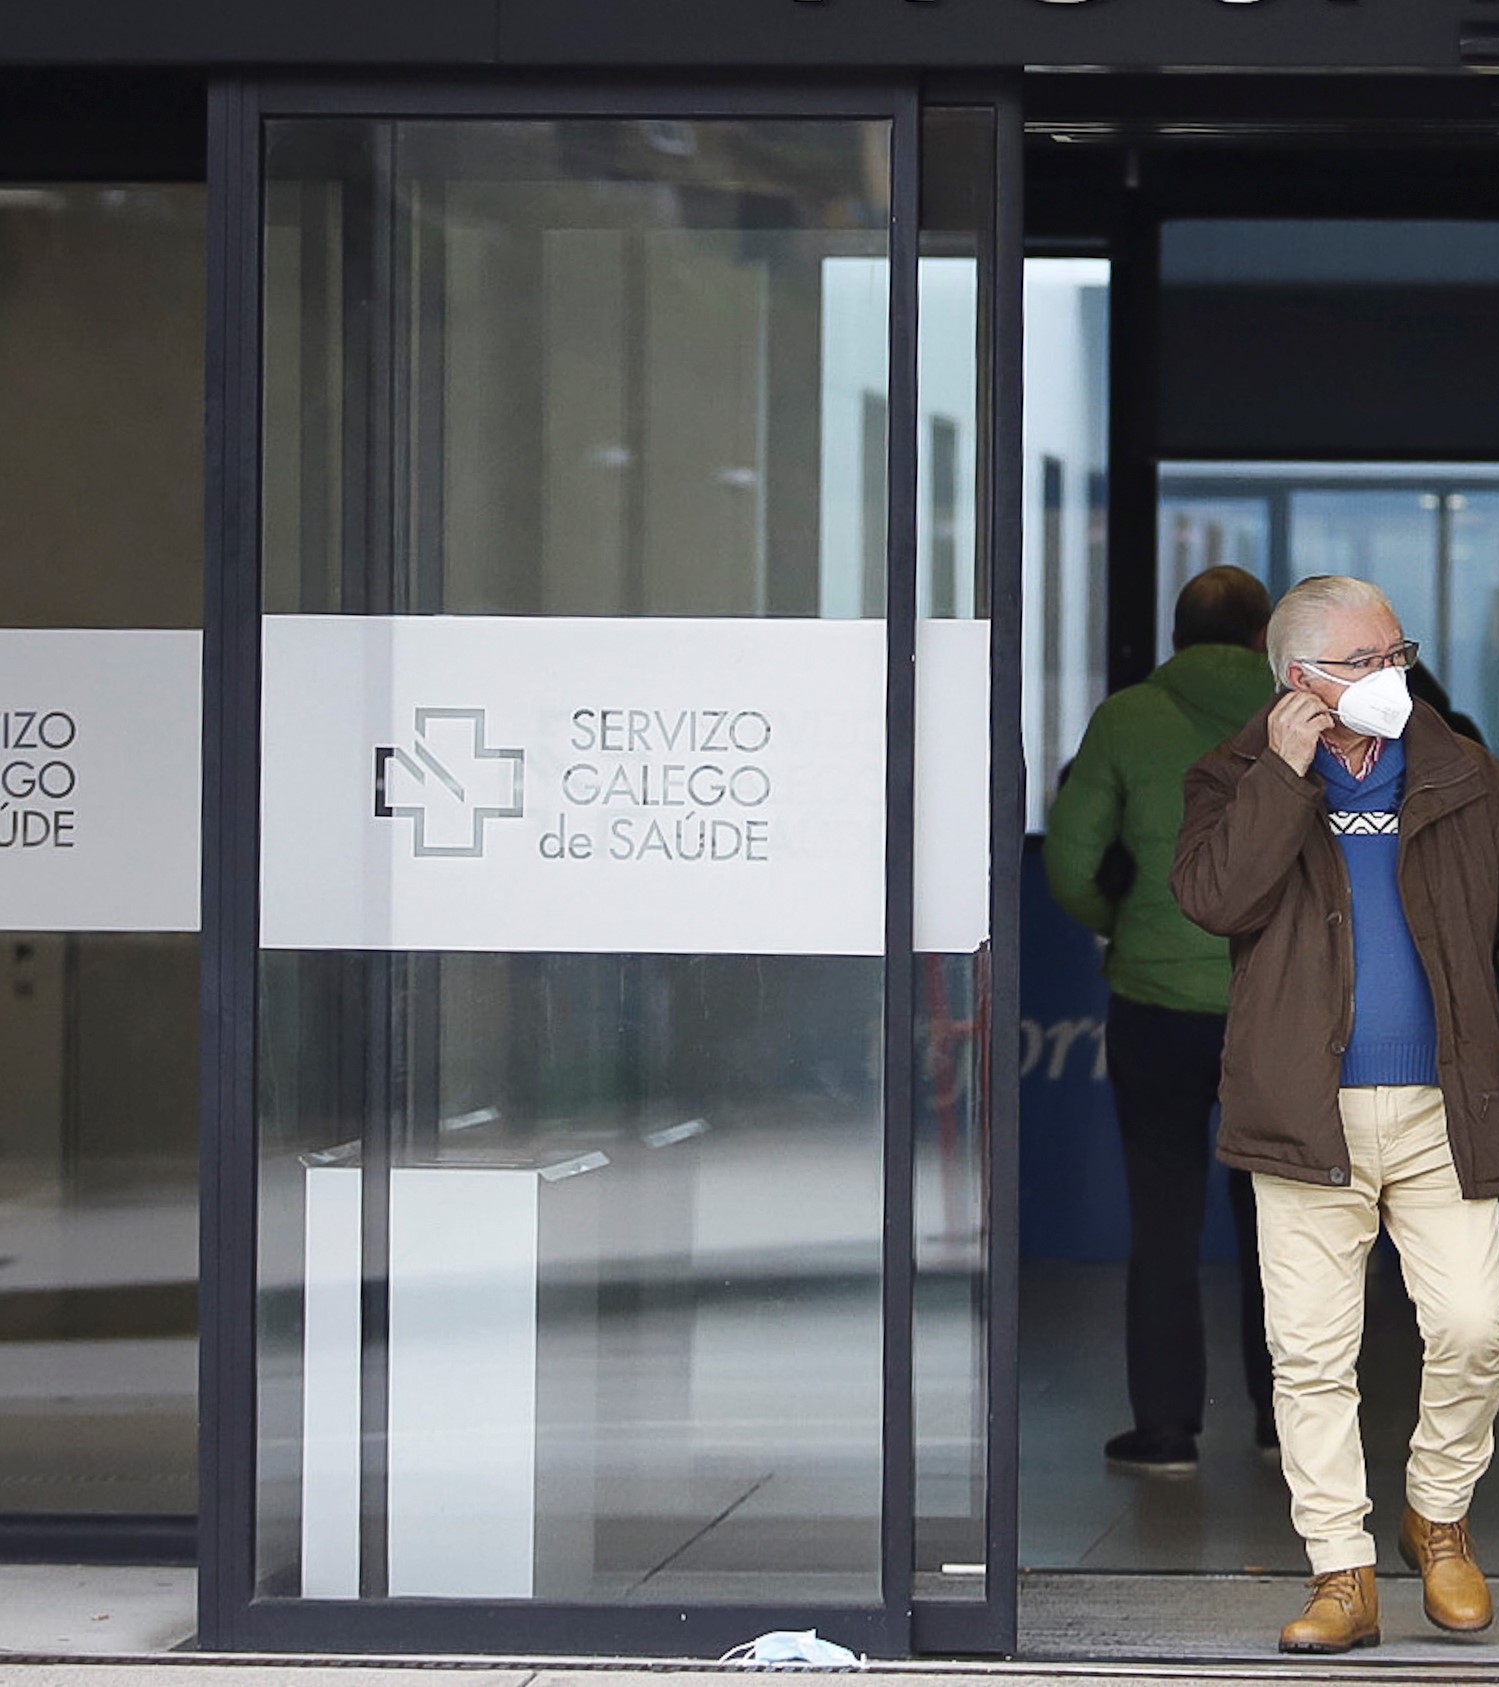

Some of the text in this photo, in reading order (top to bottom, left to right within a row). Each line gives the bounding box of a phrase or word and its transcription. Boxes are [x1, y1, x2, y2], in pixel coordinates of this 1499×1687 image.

[571, 709, 772, 753] SERVIZO
[562, 763, 772, 807] GALEGO
[538, 811, 769, 861] de SAÚDE
